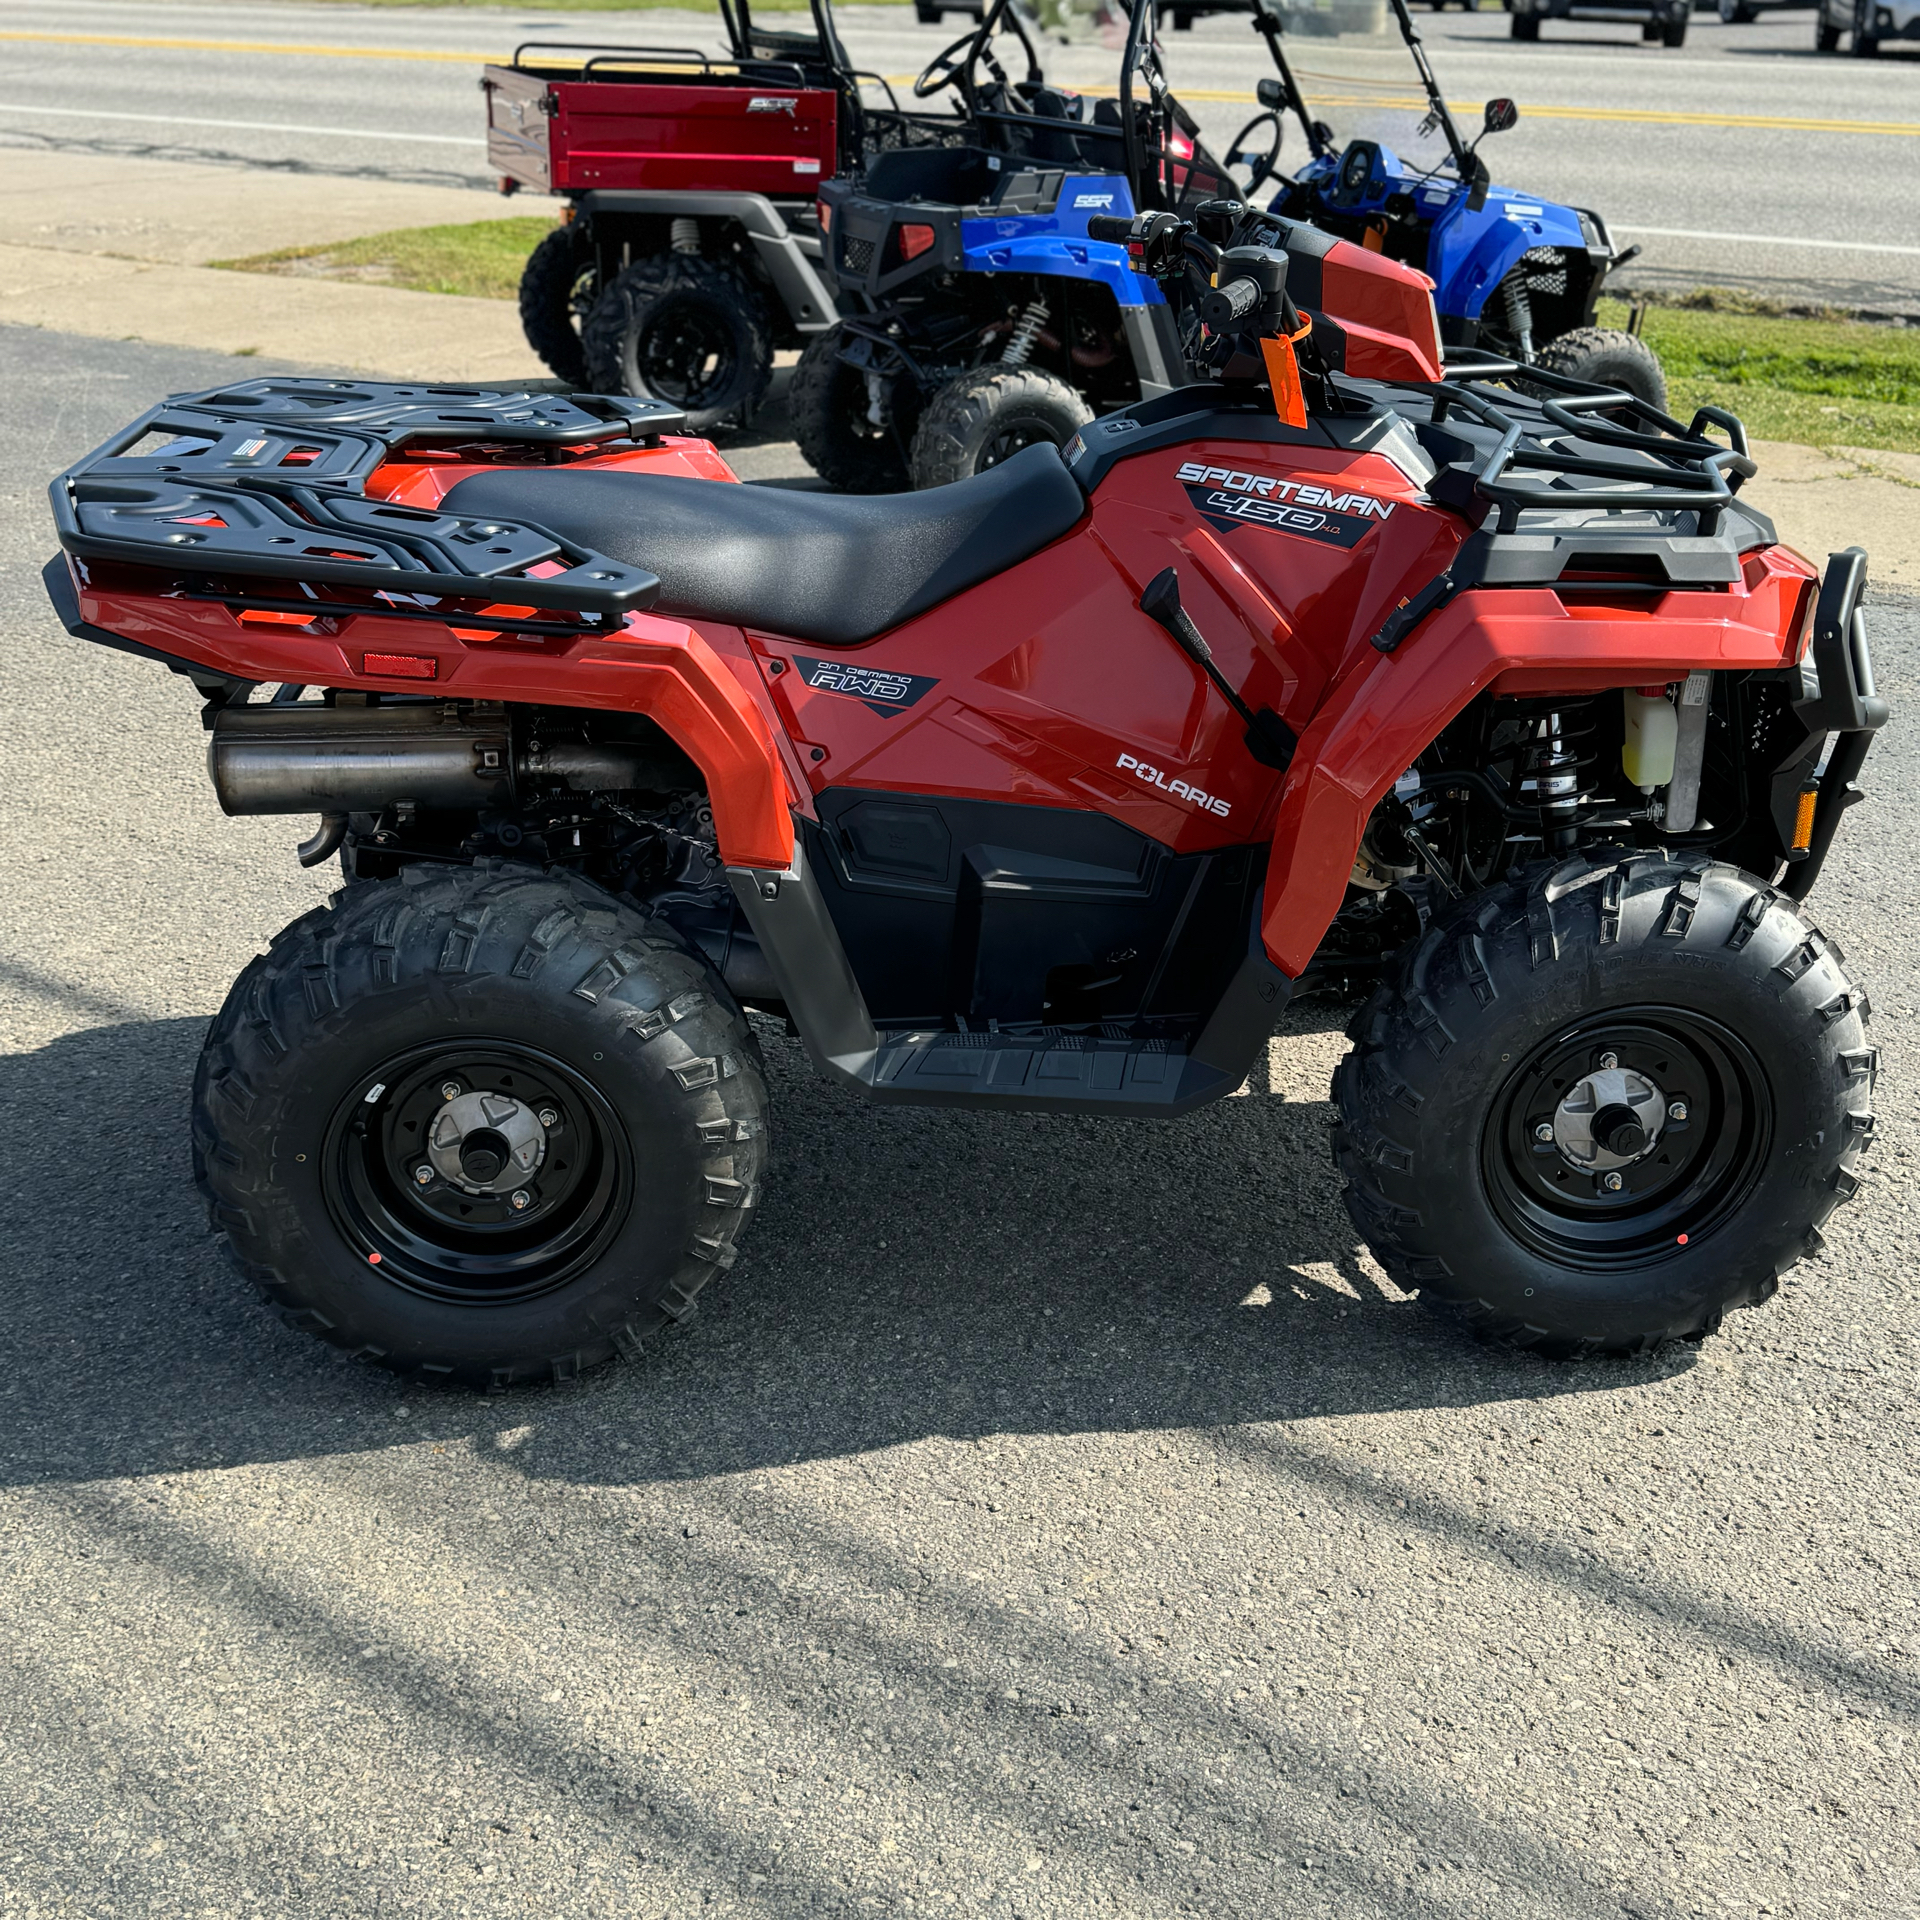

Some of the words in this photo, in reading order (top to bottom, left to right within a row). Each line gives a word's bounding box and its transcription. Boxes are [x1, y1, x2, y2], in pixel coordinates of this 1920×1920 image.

[1073, 194, 1114, 210] SSR
[1175, 462, 1398, 520] SPORTSMAN
[1207, 491, 1326, 531] 450
[809, 670, 908, 700] AWD
[817, 661, 840, 671] ON
[846, 667, 912, 684] DEMAND
[1115, 752, 1232, 818] POLARIS
